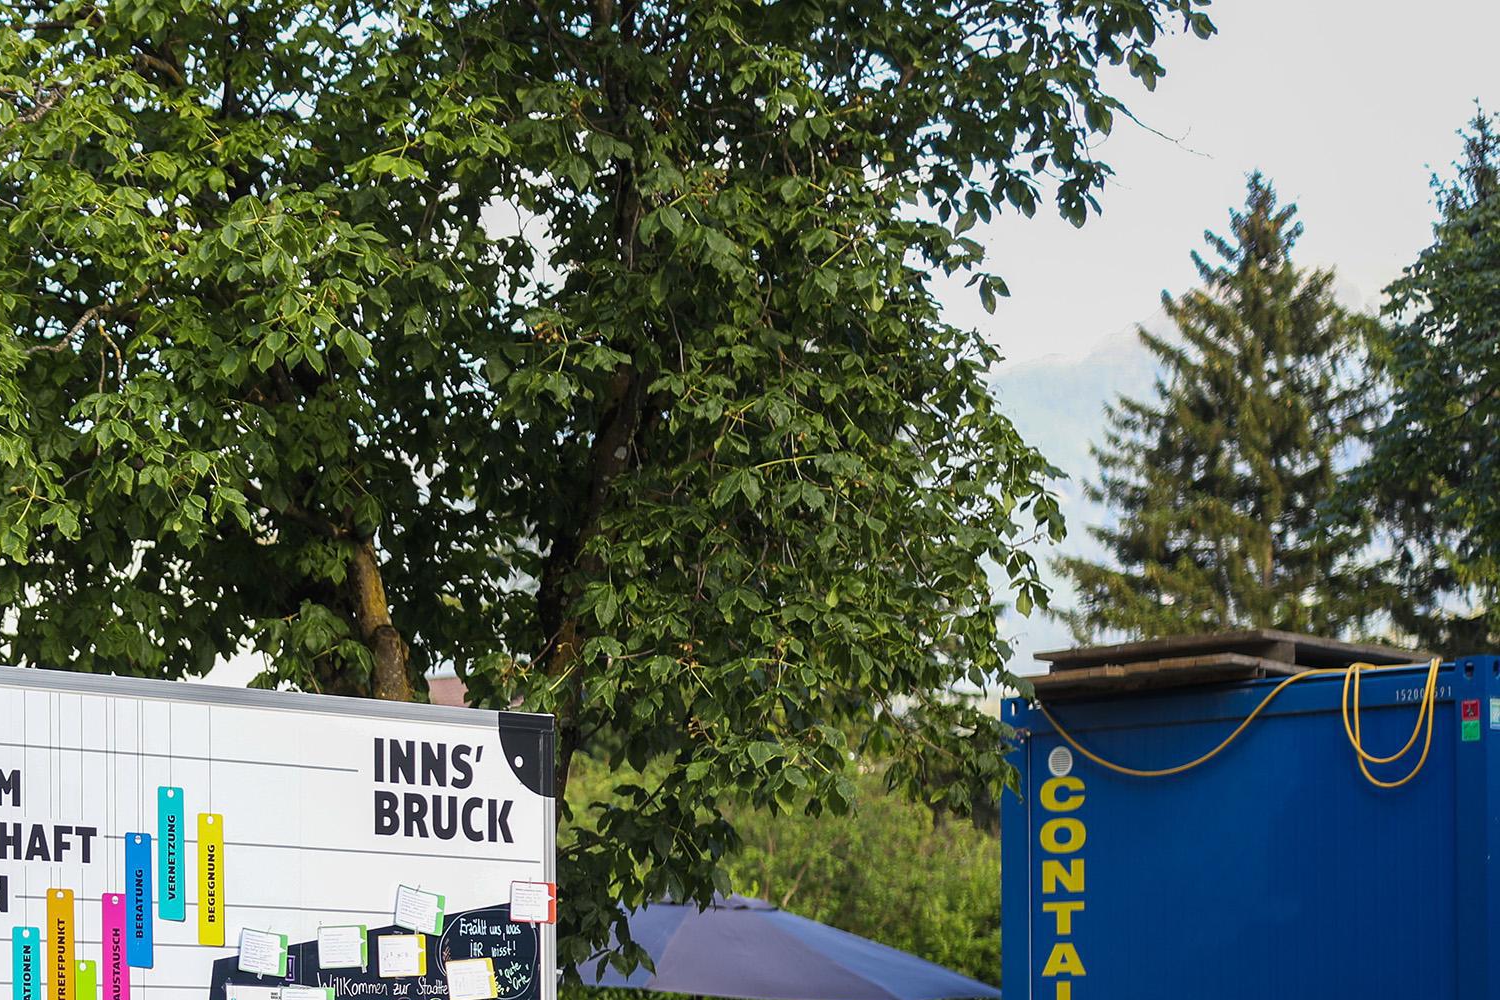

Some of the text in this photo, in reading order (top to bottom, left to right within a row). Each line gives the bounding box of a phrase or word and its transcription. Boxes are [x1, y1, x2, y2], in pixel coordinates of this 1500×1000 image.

[374, 737, 484, 790] INNS'
[374, 790, 514, 844] BRUCK
[168, 814, 176, 900] VERNETZUNG
[207, 844, 216, 923] BEGEGNUNG
[135, 869, 143, 939] BERATUNG
[393, 982, 412, 996] zur
